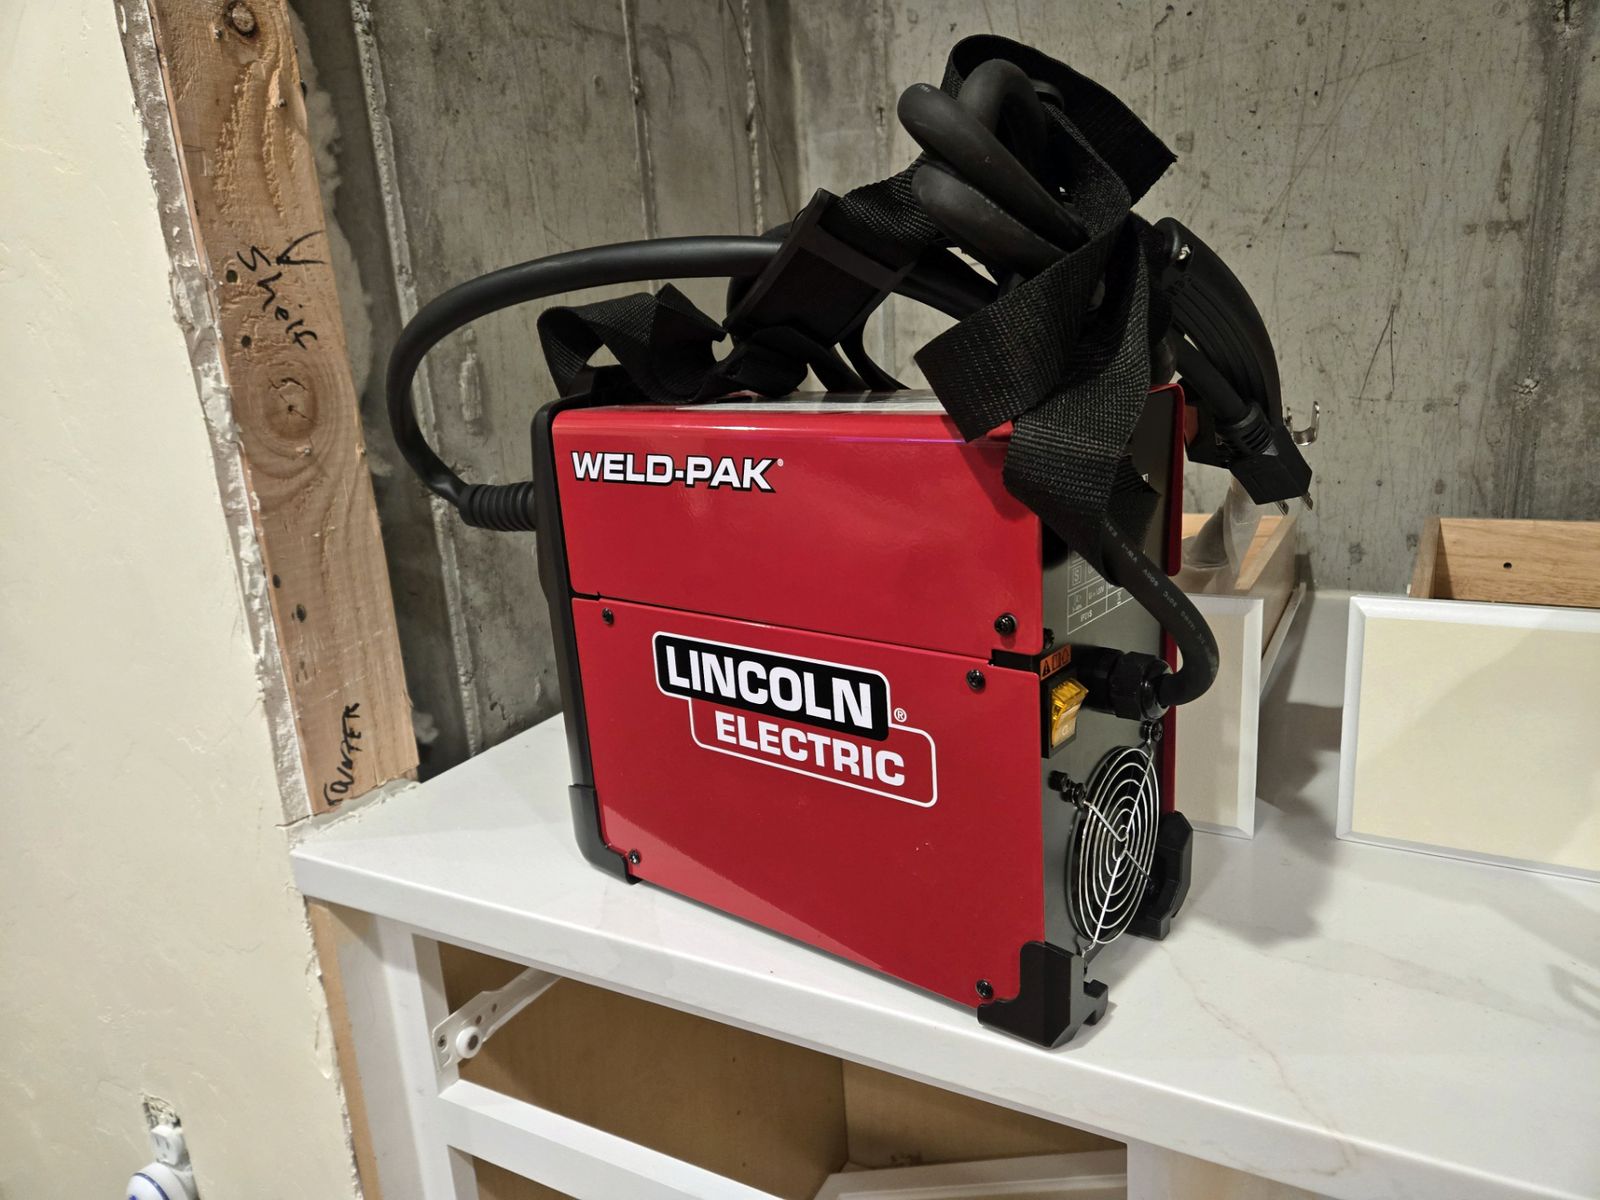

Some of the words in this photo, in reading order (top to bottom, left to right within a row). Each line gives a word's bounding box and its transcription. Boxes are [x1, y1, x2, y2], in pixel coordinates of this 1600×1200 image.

[571, 451, 777, 492] WELD-PAK
[665, 644, 873, 729] LINCOLN
[714, 710, 906, 787] ELECTRIC
